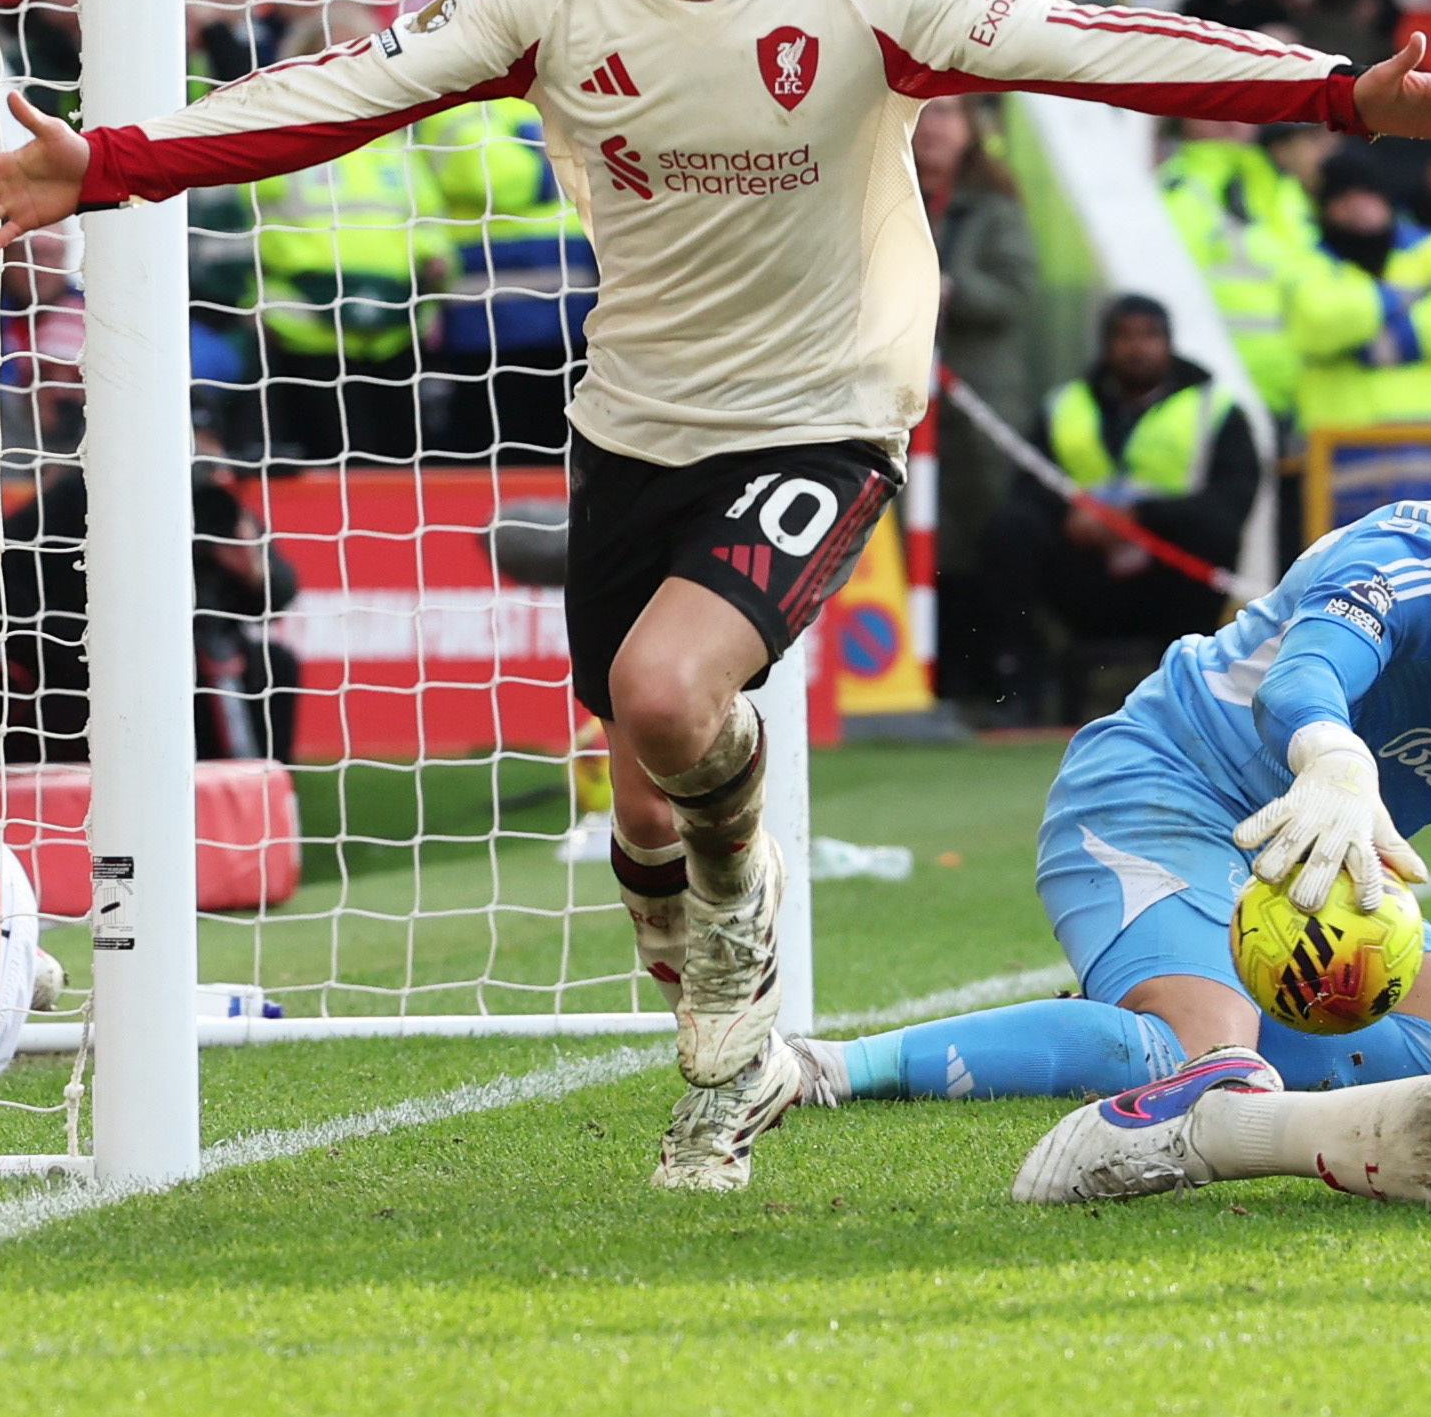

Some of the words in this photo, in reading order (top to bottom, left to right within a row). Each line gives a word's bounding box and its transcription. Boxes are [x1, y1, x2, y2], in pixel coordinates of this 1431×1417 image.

[658, 143, 809, 172] standard
[664, 162, 819, 195] chartered
[724, 472, 839, 557] 10
[1349, 604, 1382, 633] room
